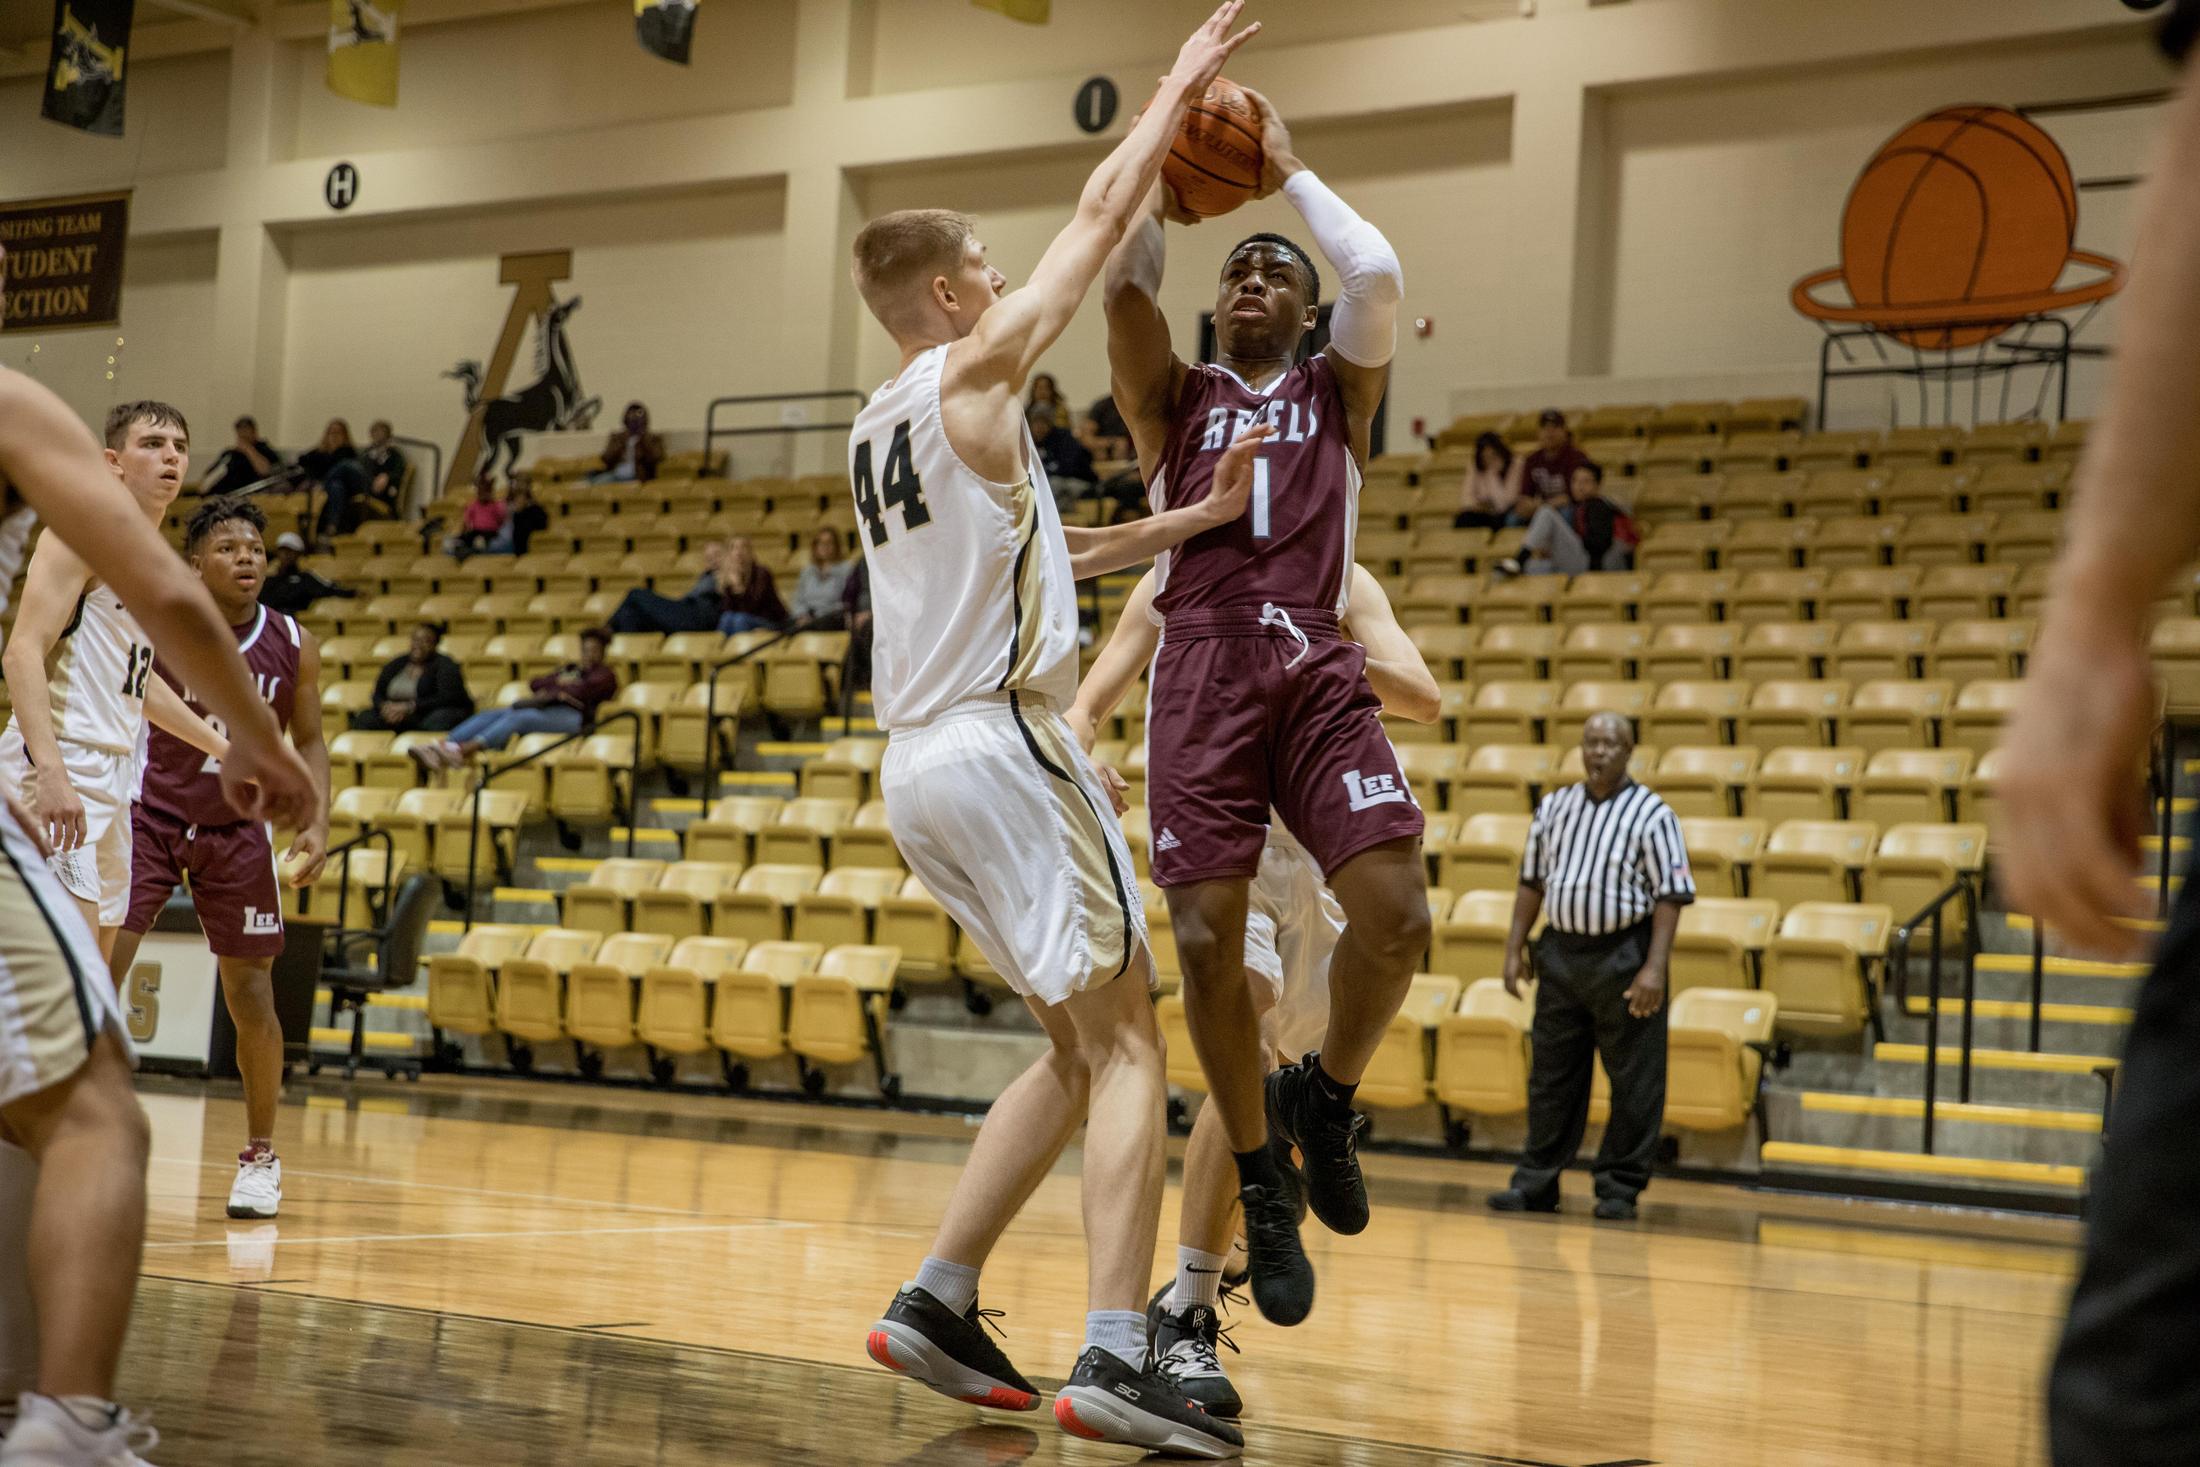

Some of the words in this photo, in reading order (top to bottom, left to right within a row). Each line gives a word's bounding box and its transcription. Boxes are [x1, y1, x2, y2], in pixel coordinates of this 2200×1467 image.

[329, 168, 354, 205] H
[57, 211, 102, 236] TEAM
[854, 418, 933, 549] 44
[1253, 457, 1269, 537] 1
[122, 642, 153, 700] 12
